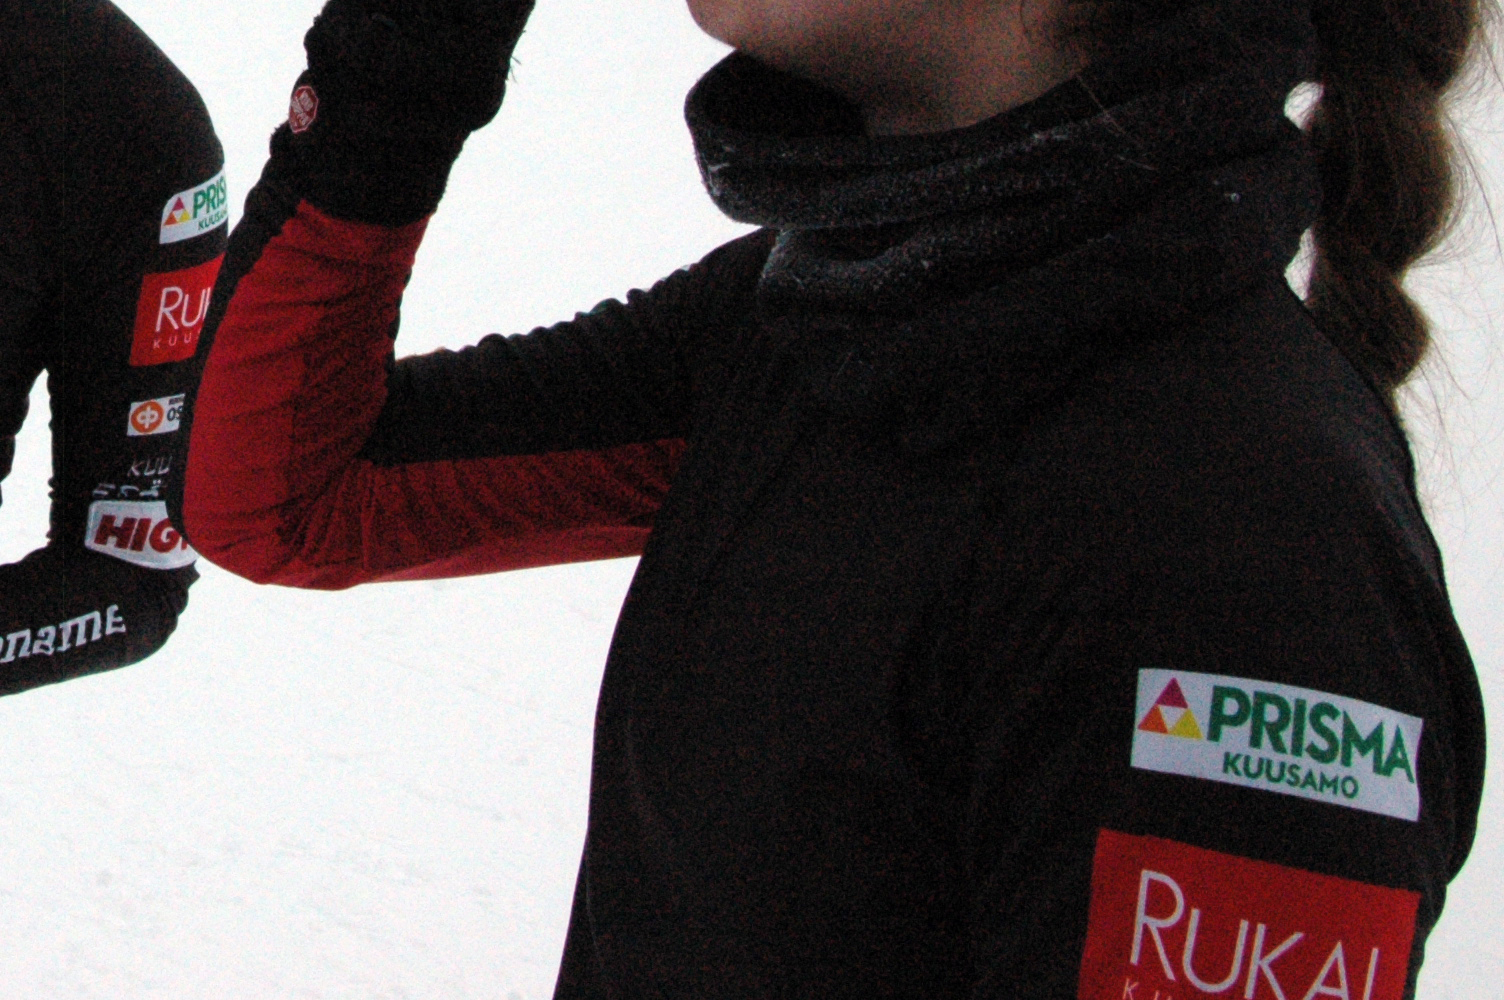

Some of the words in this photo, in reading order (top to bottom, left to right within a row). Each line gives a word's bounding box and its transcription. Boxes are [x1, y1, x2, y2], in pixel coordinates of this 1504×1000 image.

[95, 514, 188, 553] HIG
[1206, 685, 1415, 784] PRISMA
[1222, 751, 1359, 799] KUUSAMO
